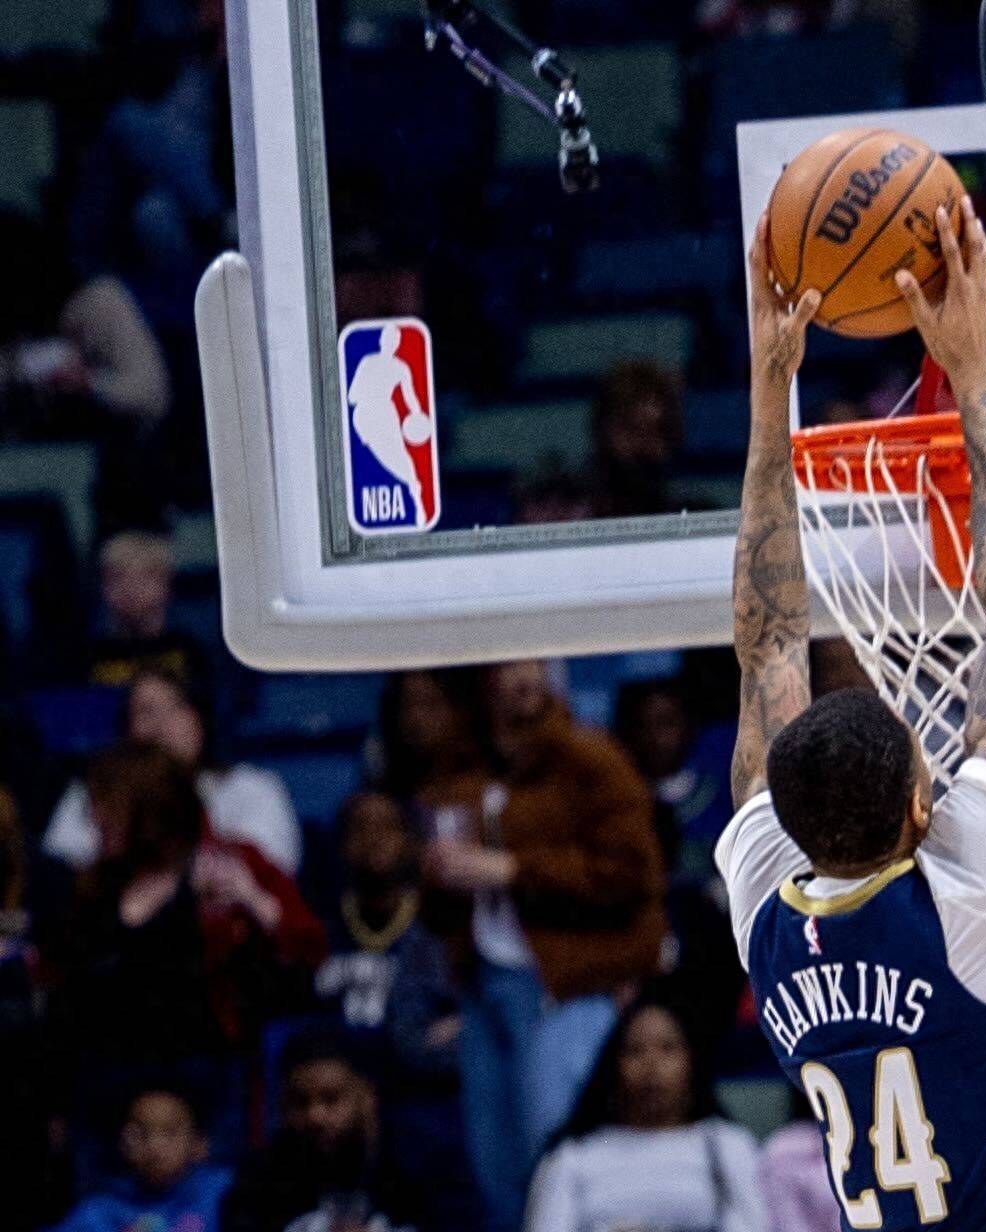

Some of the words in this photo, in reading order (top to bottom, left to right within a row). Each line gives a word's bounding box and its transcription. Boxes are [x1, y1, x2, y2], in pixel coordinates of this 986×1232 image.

[815, 143, 918, 245] Wilson
[362, 485, 406, 523] NBA
[761, 961, 933, 1056] HAWKINS
[799, 1047, 951, 1230] 24
